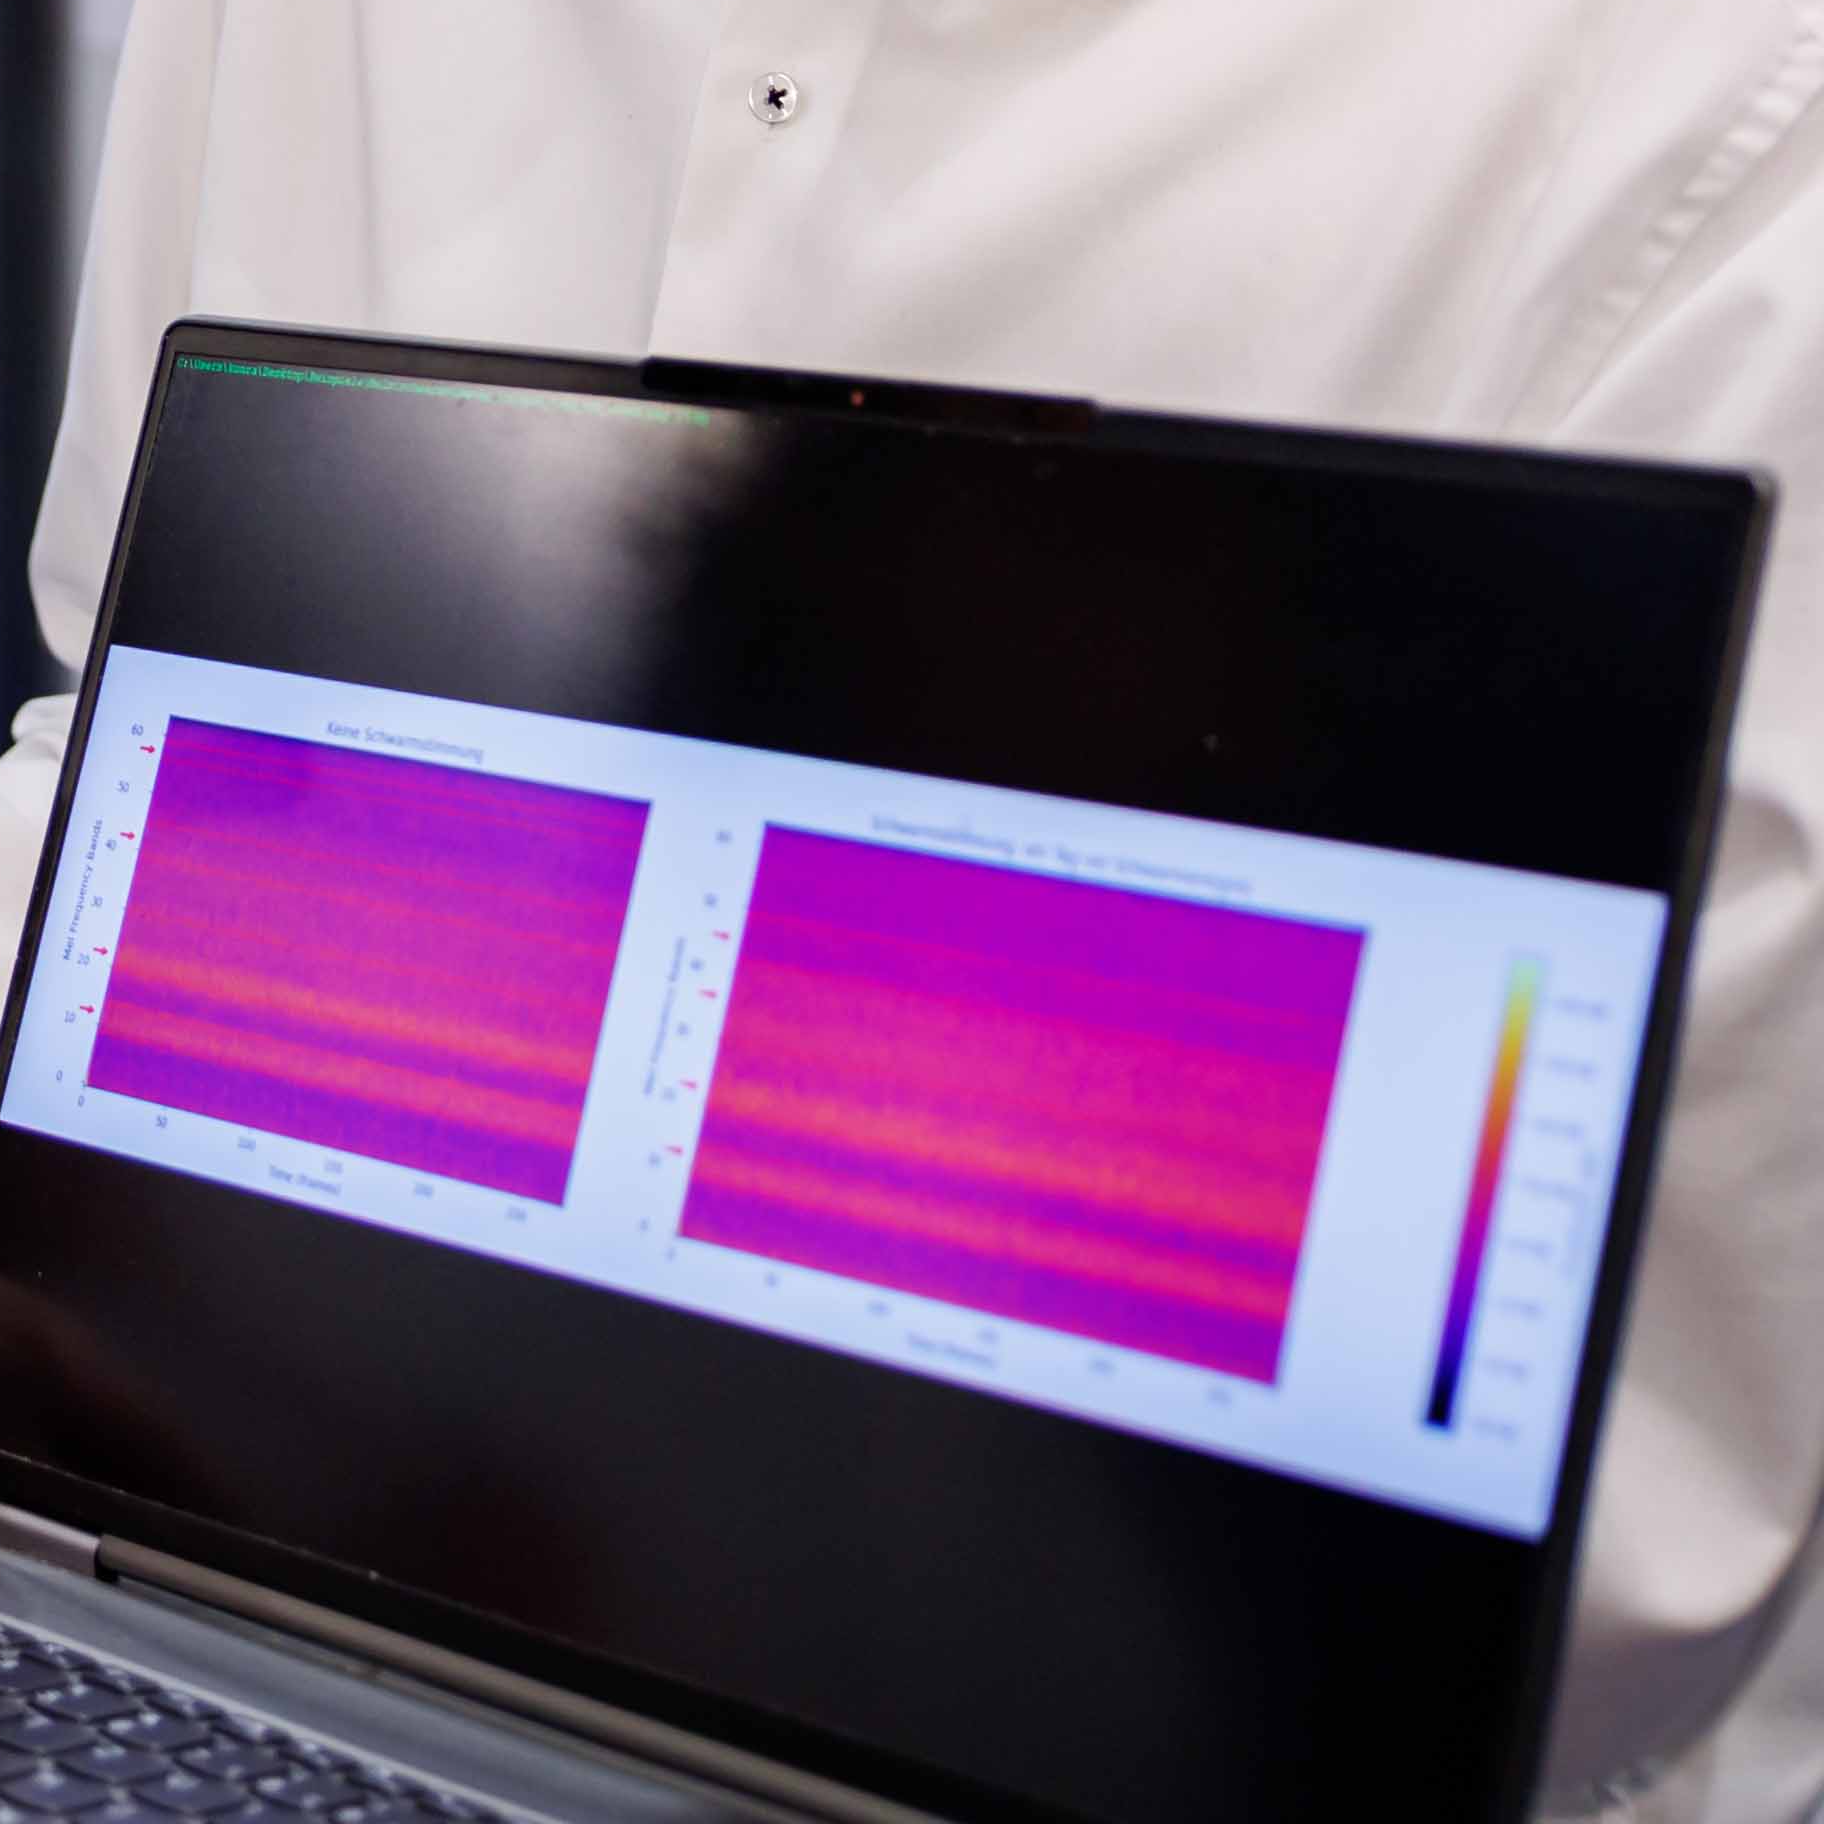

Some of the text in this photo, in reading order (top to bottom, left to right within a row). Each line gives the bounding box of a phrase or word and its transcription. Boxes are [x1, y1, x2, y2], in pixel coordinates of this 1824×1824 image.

[130, 723, 144, 737] 60
[326, 721, 360, 738] Keine
[117, 779, 130, 793] 50
